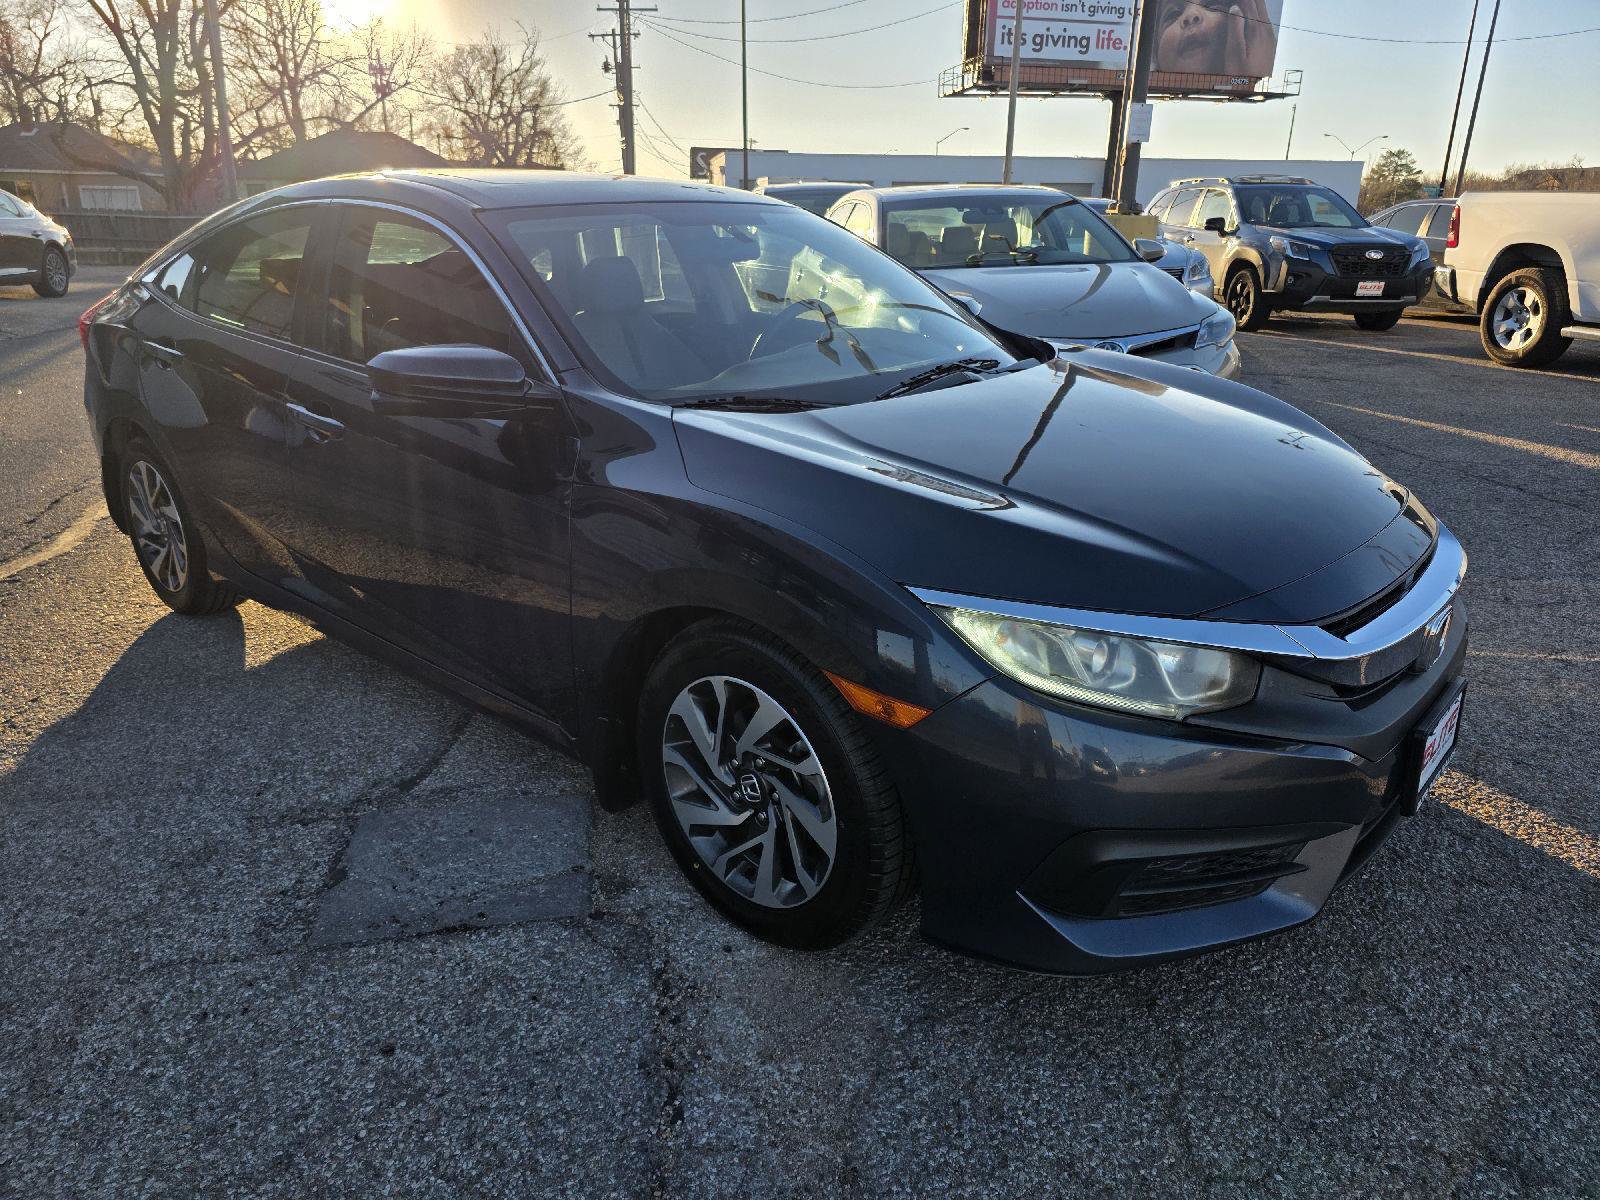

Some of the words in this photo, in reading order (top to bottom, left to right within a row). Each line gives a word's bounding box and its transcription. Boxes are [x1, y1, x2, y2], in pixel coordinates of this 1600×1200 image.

[1061, 0, 1086, 13] isn't
[1088, 0, 1125, 19] giving
[1032, 27, 1090, 55] giving
[1095, 29, 1127, 51] life.
